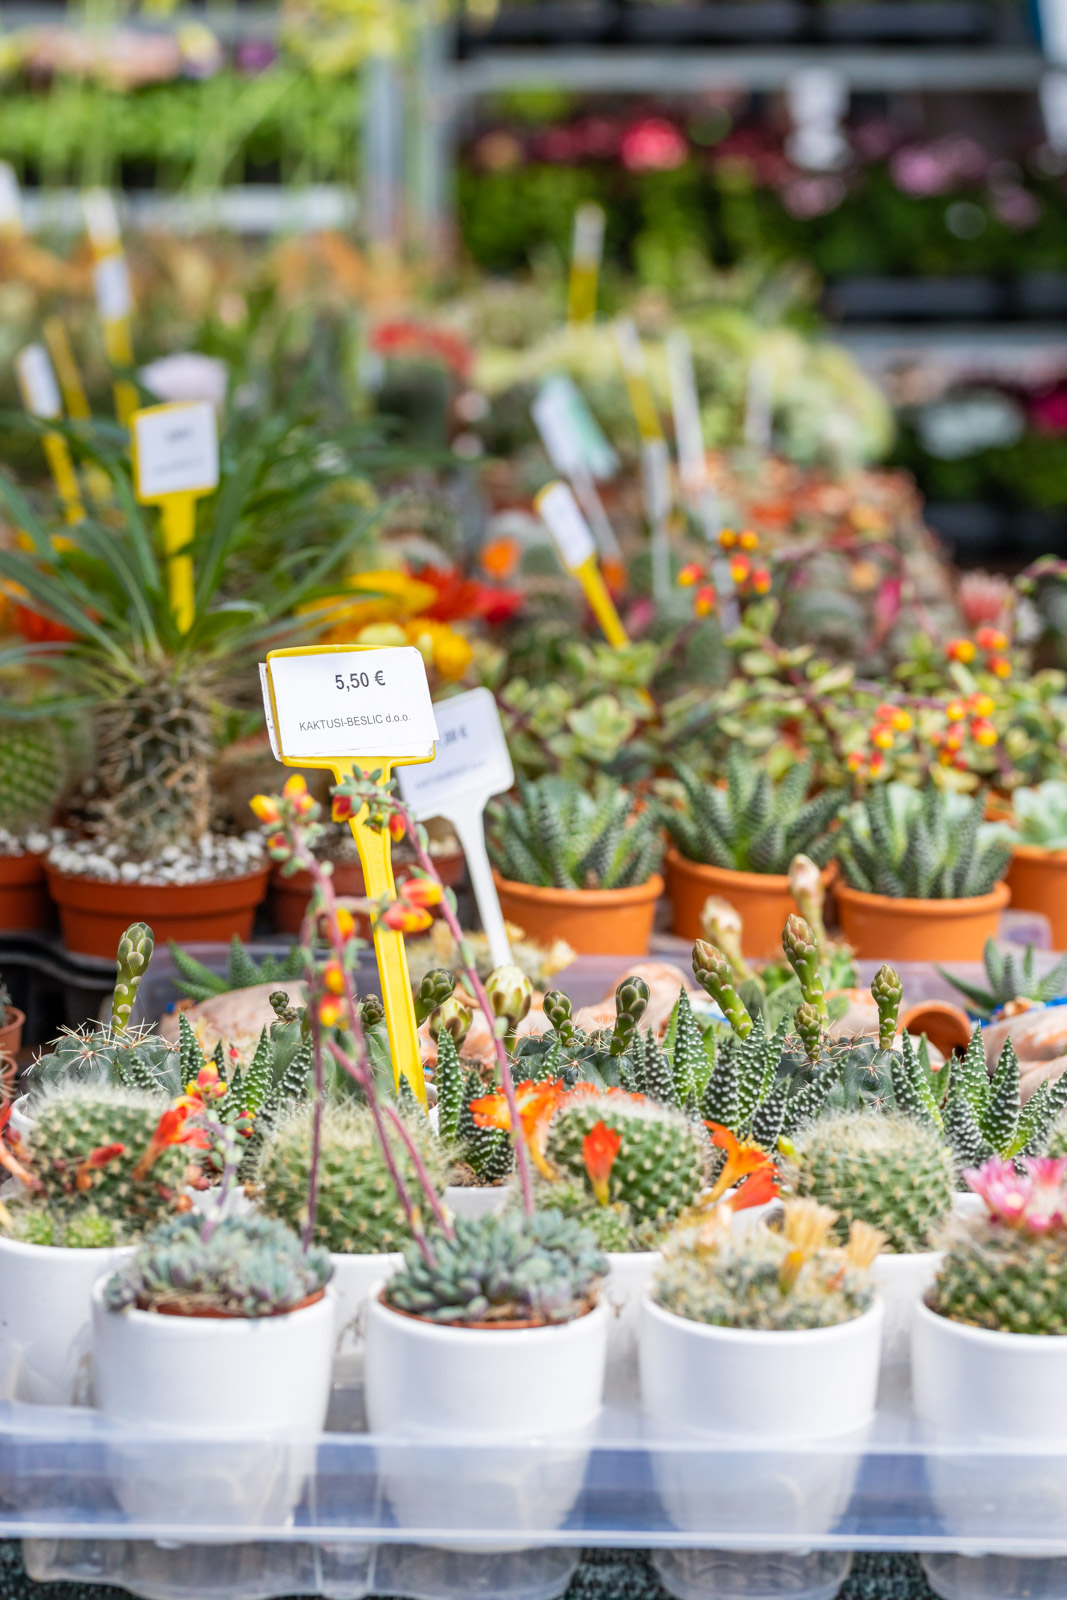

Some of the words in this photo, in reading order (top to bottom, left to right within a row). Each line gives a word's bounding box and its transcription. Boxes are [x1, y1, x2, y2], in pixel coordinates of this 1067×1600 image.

[335, 672, 369, 692] 5,50
[374, 670, 386, 686] €
[299, 714, 383, 731] KAKTUSI-BESLIC
[385, 713, 411, 723] d.o.o.
